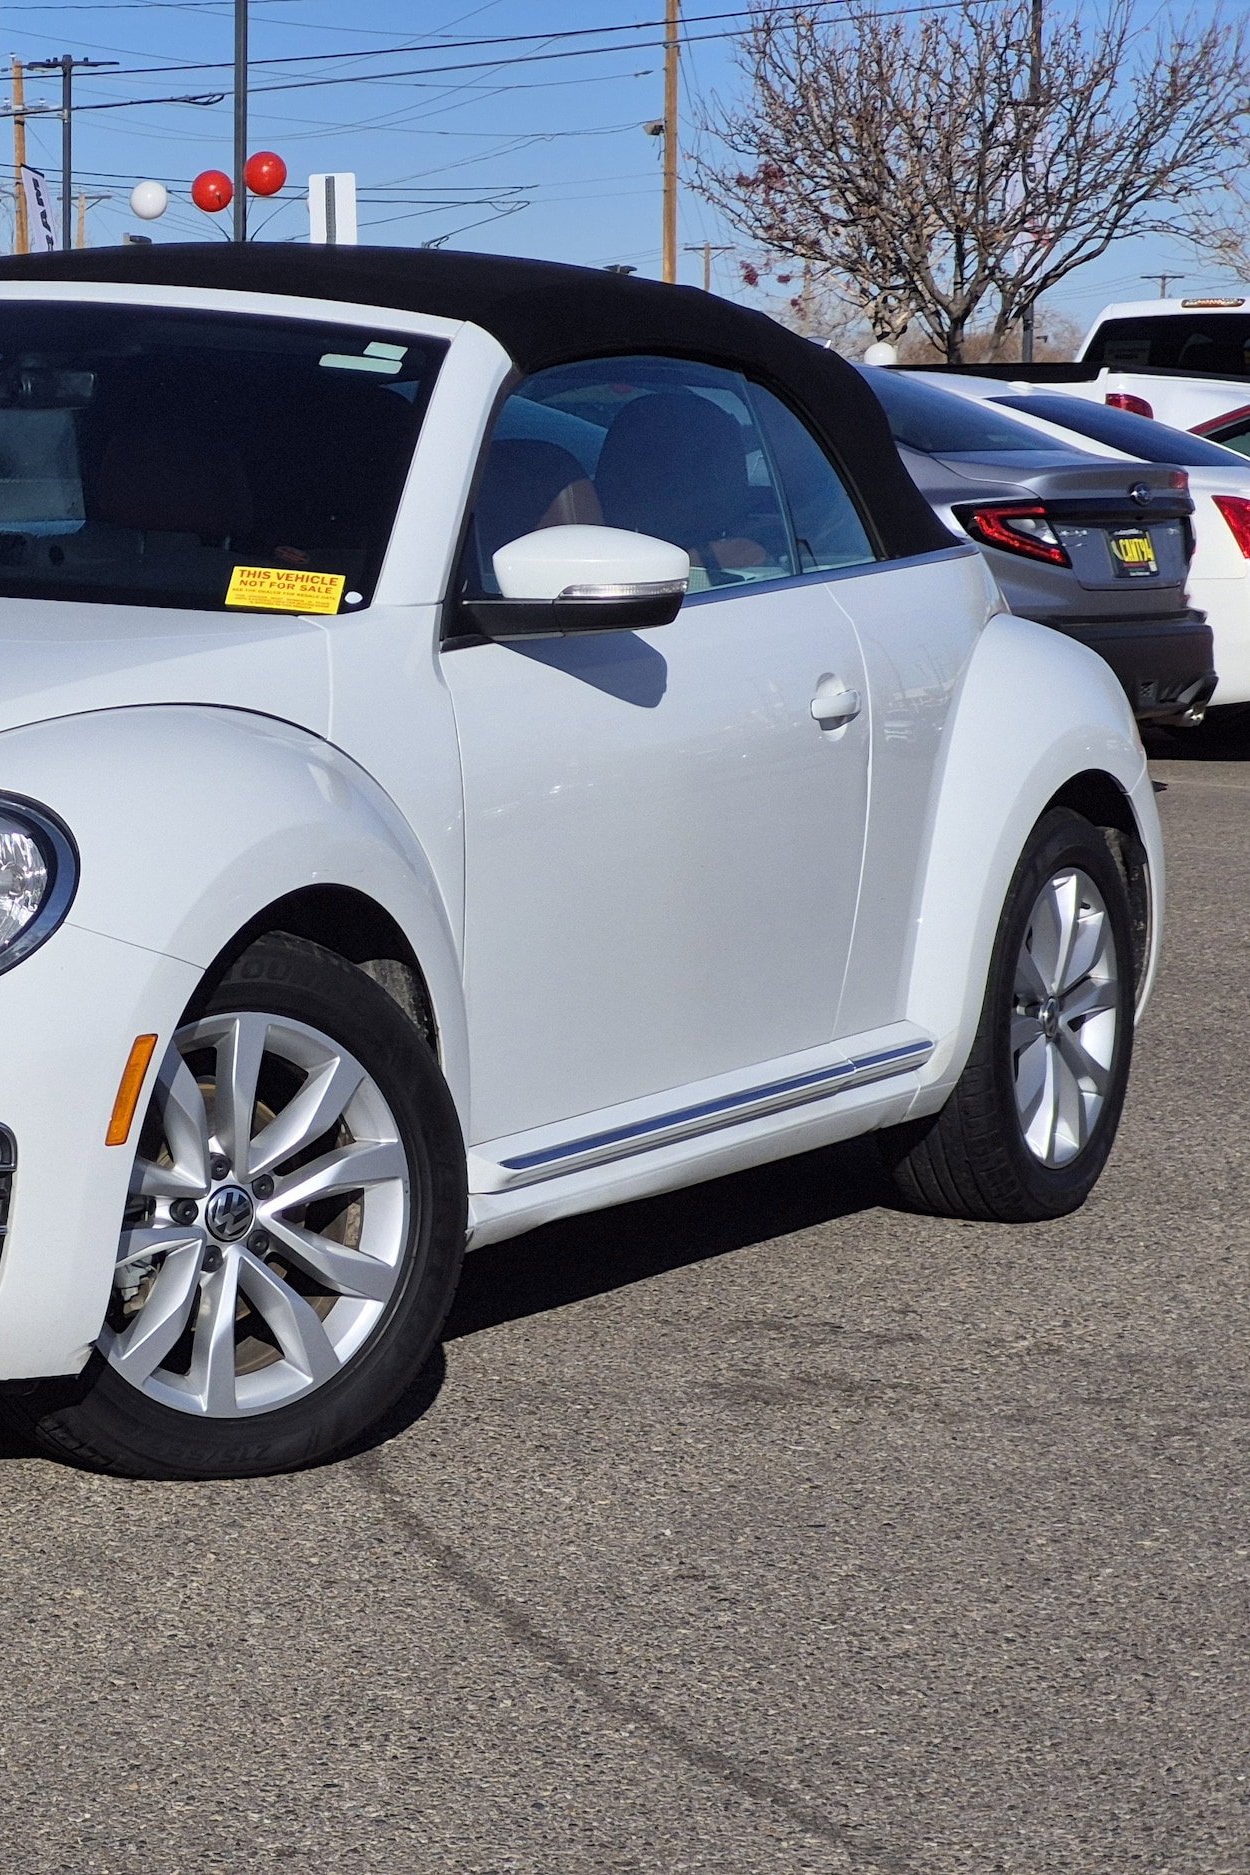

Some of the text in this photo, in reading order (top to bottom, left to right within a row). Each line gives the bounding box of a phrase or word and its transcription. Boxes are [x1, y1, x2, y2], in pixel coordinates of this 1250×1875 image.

[239, 569, 339, 586] THIS VEHICLE
[239, 579, 333, 594] NOT FOR SALE
